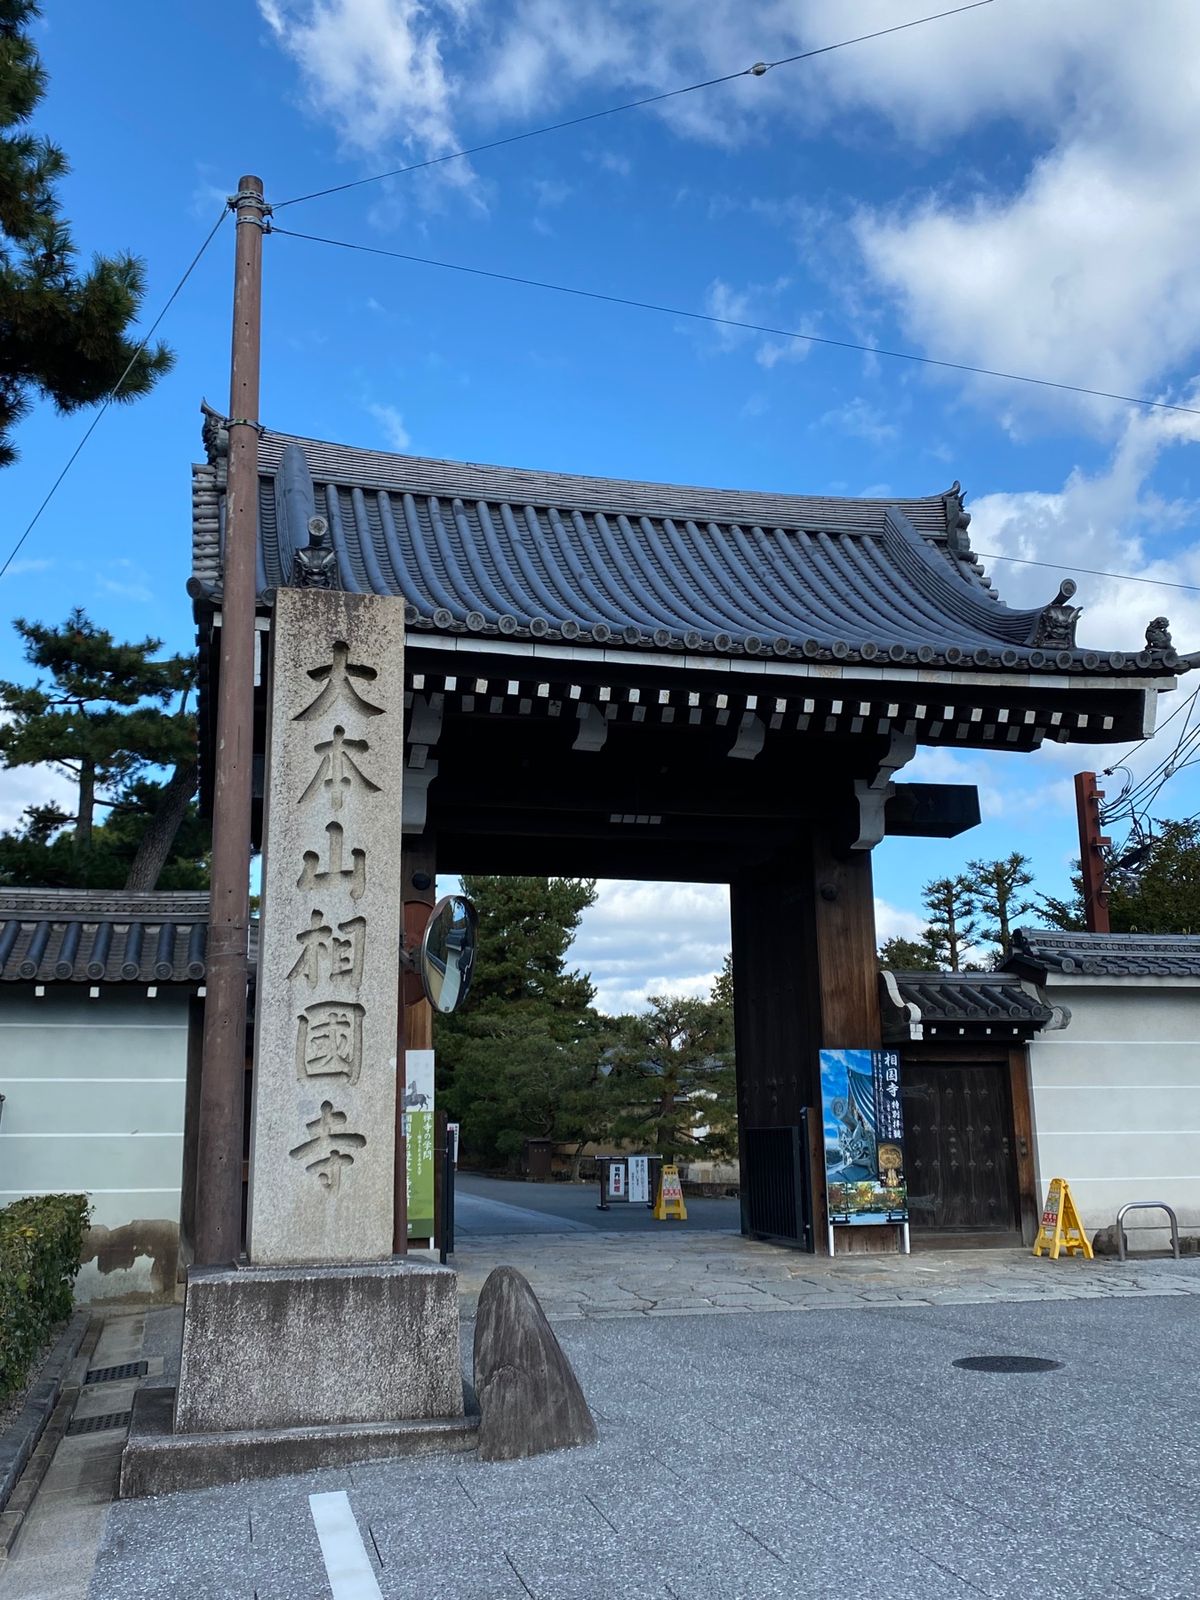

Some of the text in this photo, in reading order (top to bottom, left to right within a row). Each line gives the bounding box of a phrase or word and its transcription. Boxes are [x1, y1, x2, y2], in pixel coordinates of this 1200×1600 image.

[288, 640, 386, 1190] 大本山相國寺
[884, 1053, 899, 1097] 相国寺
